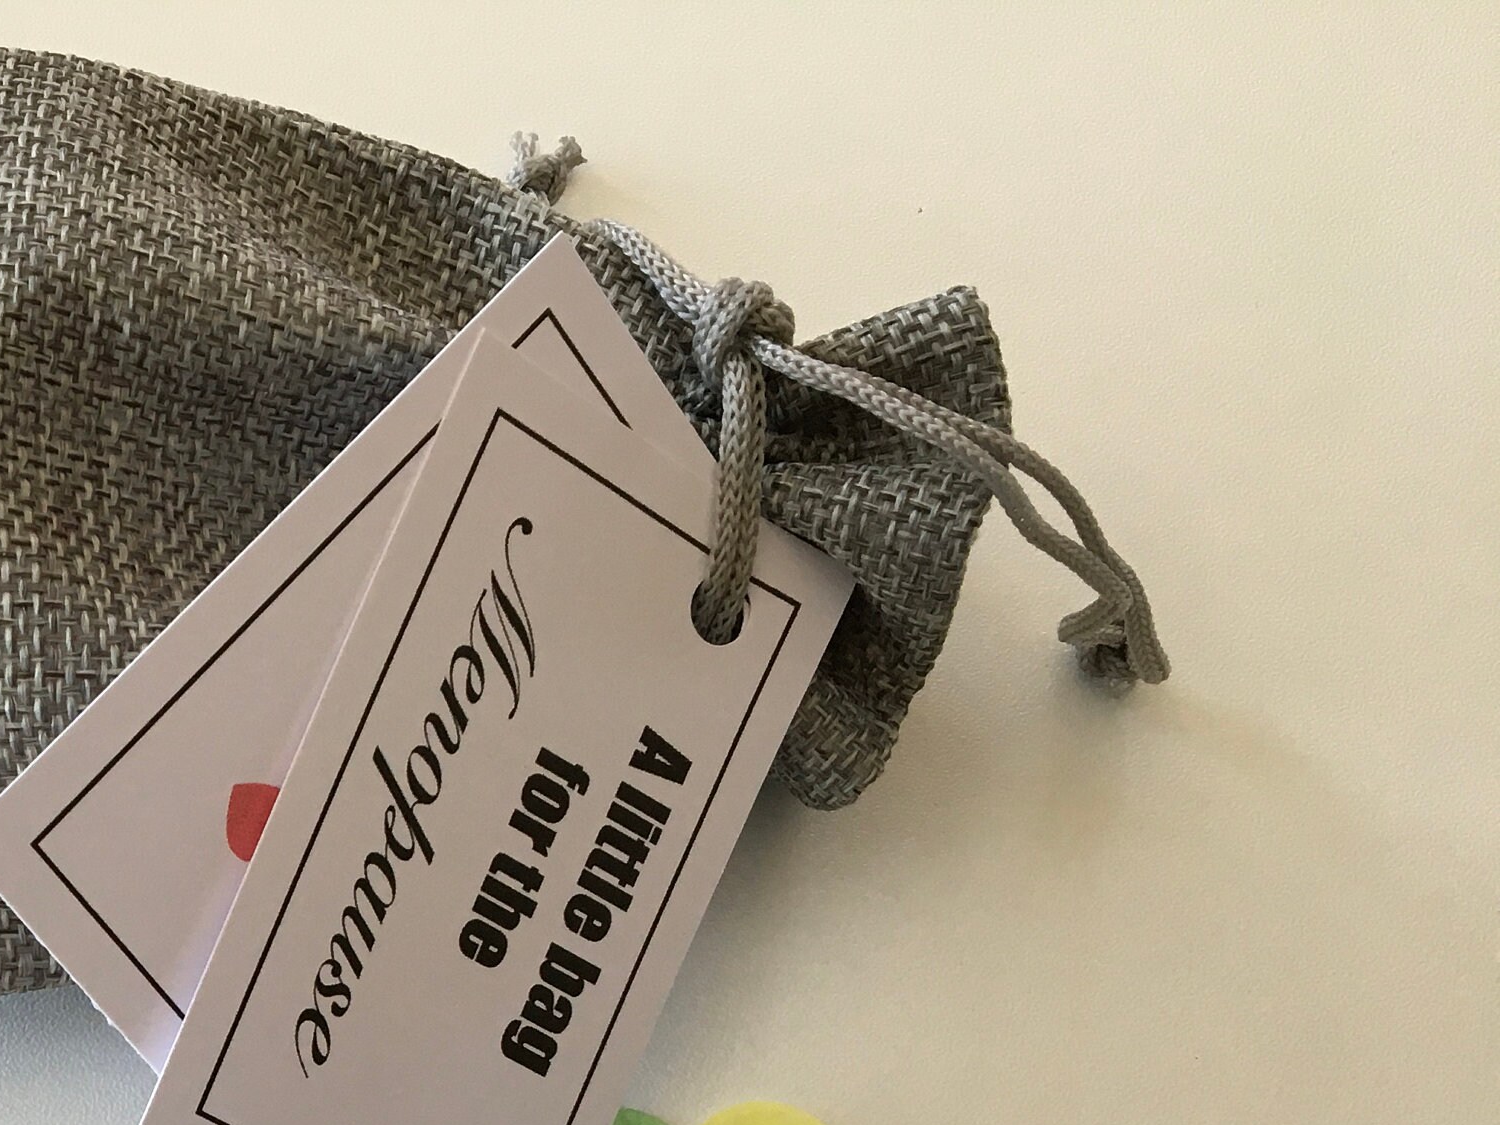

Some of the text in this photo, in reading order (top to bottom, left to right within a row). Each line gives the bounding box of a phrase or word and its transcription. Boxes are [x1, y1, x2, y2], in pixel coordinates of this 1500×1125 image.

[294, 516, 536, 1078] Menopause
[458, 746, 591, 969] for the
[500, 724, 693, 1078] A little bag
